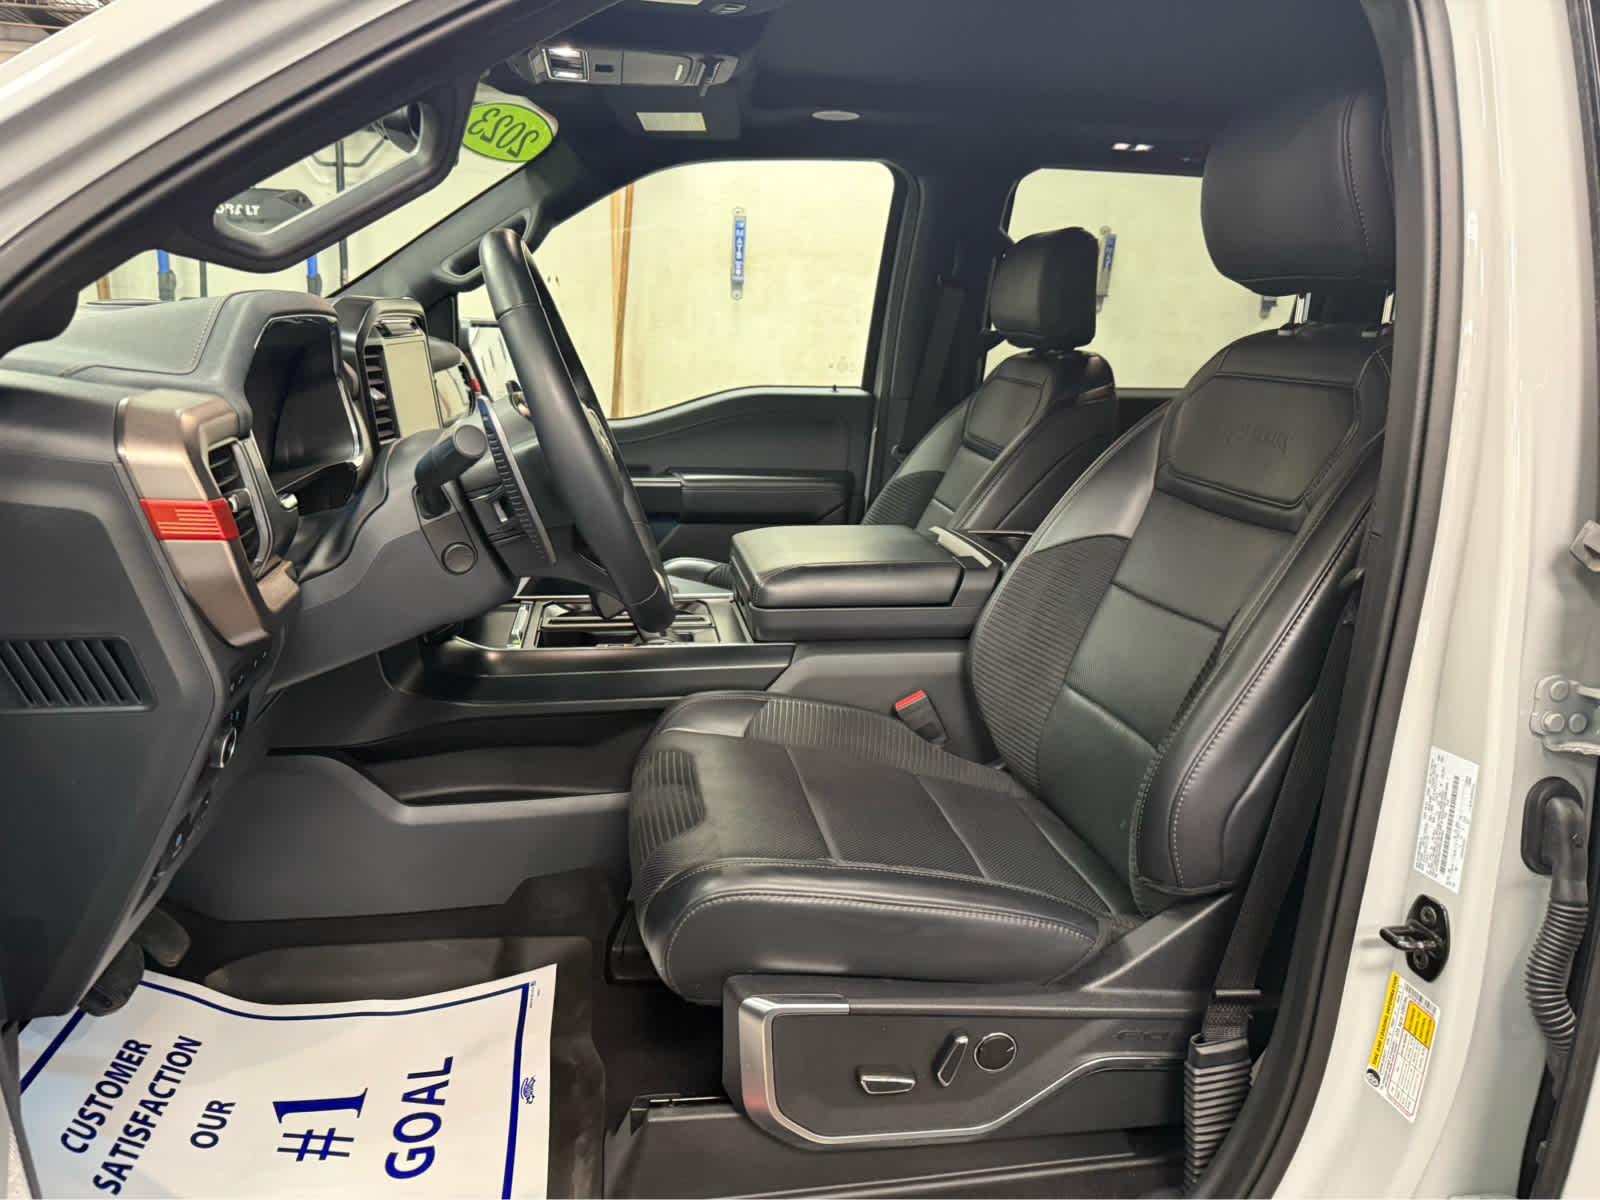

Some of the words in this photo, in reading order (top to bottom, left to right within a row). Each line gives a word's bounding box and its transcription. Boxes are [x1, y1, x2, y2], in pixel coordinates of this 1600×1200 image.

[61, 1040, 152, 1153] CUSTOMER
[93, 1036, 202, 1195] SATISFACTION
[191, 1101, 235, 1148] OUR
[273, 1088, 368, 1161] #1
[385, 1057, 453, 1179] GOAL
